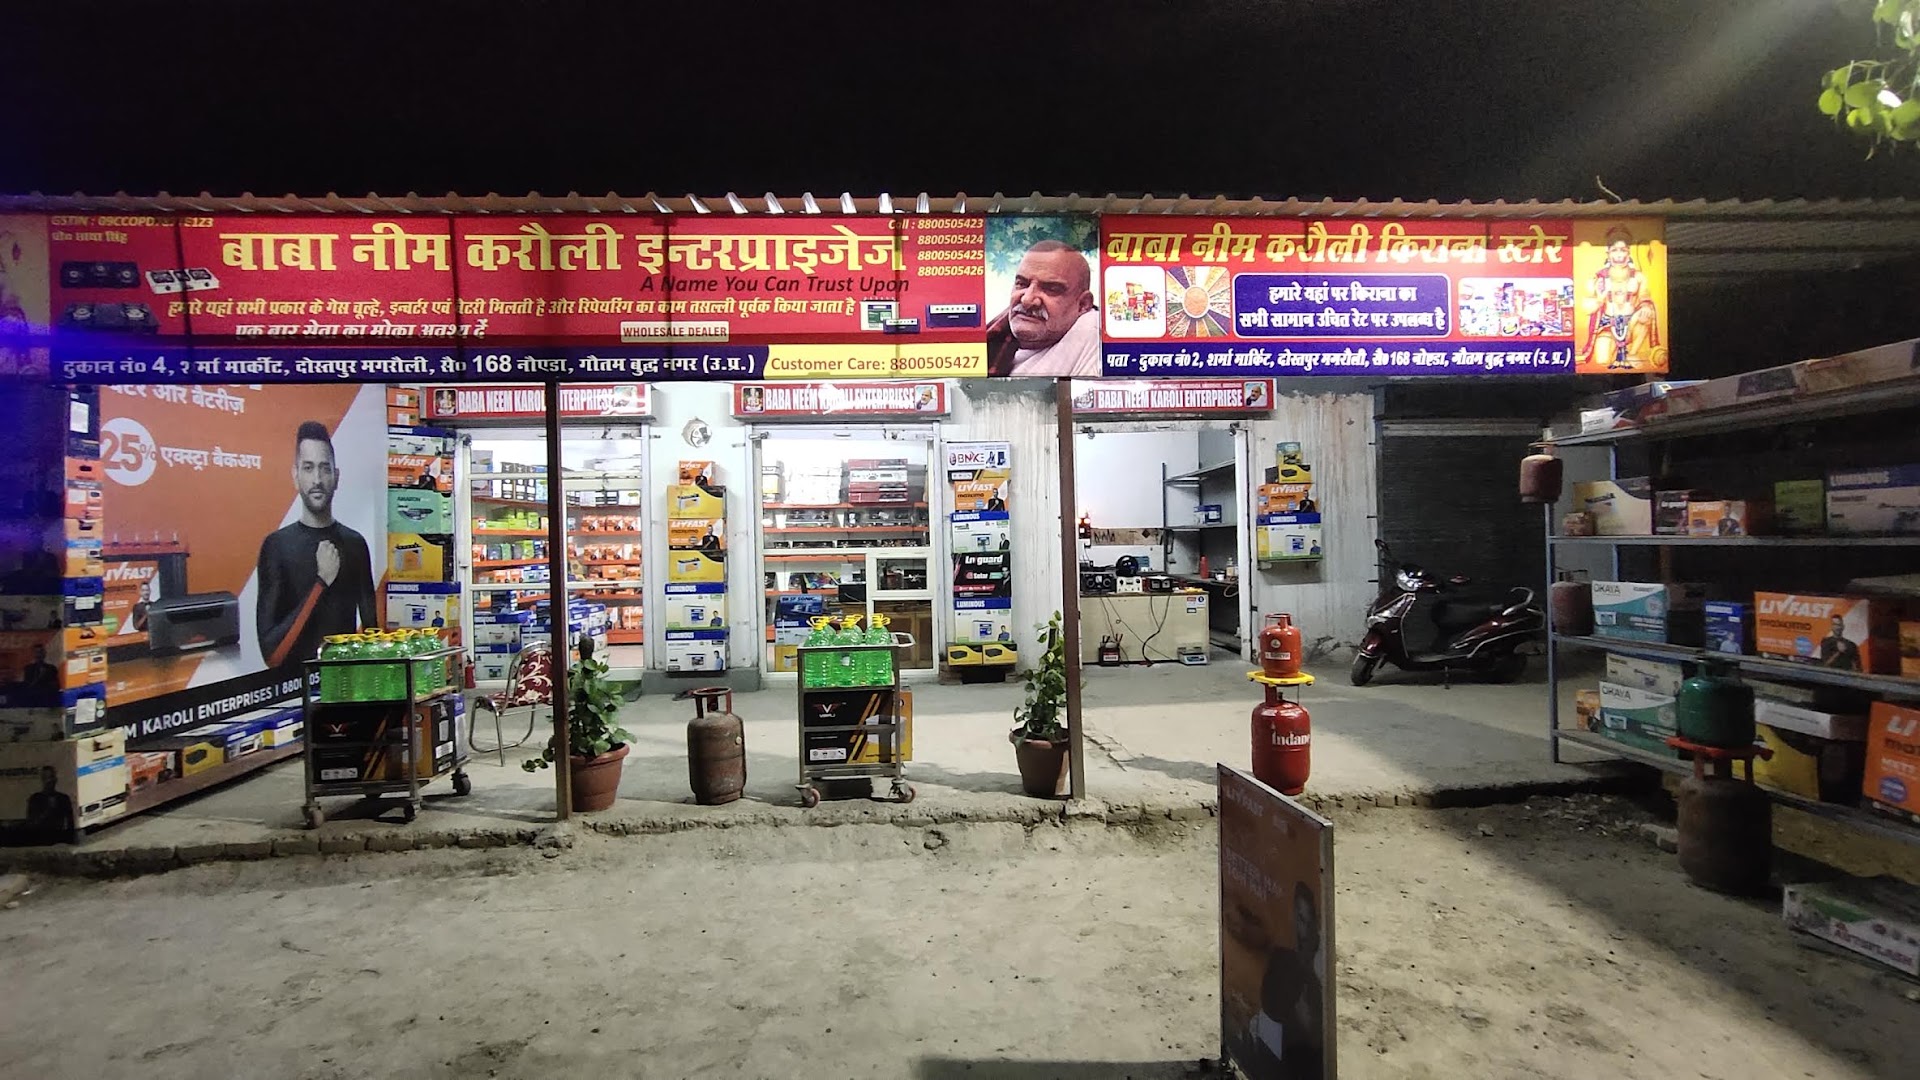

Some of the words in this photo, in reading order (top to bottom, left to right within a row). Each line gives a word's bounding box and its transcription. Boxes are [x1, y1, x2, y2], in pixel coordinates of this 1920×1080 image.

[917, 218, 984, 230] 8800505423
[219, 232, 339, 271] बाबा
[350, 222, 451, 272] नीम
[463, 221, 625, 272] करौली
[917, 234, 984, 245] 8800505424
[1106, 232, 1188, 263] बाबा
[1192, 221, 1262, 264] नीम
[1265, 221, 1374, 264] करौली
[1375, 221, 1494, 265] किराना
[1497, 223, 1569, 265] स्टोर
[917, 250, 984, 261] 8800505425
[917, 265, 984, 277] 8800505426
[639, 276, 655, 292] A
[660, 275, 718, 292] Name
[725, 275, 758, 292] You
[764, 275, 800, 292] Can
[806, 275, 854, 292] Trust
[859, 275, 909, 296] Upon
[1268, 281, 1303, 304] हमारे
[1304, 280, 1330, 304] यहां
[1330, 286, 1350, 302] पर
[1350, 280, 1397, 302] किराना
[1397, 286, 1418, 302] का
[236, 298, 265, 316] सभी
[309, 298, 324, 315] के
[488, 297, 534, 315] मिलती
[535, 297, 547, 316] है
[548, 297, 574, 315] और
[635, 299, 655, 314] का
[657, 298, 687, 315] काम
[689, 297, 736, 315] तसल्ली
[773, 297, 807, 314] किया
[810, 299, 842, 314] जाता
[844, 296, 855, 316] है
[1238, 307, 1269, 328] सभी
[1270, 312, 1315, 328] सामान
[1315, 307, 1351, 328] उचित
[1350, 307, 1370, 328] रेट
[1370, 312, 1389, 328] पर
[1435, 306, 1447, 331] है
[623, 326, 685, 338] WHOLESALE
[688, 326, 728, 337] DEALER
[63, 359, 115, 379] दुकान
[295, 356, 358, 379] दोस्तपुर
[472, 354, 513, 373] 168
[578, 354, 627, 373] गौतम
[629, 356, 659, 377] बुद्ध
[662, 356, 698, 373] नगर
[770, 356, 844, 371] Customer
[847, 356, 886, 371] Care:
[889, 355, 980, 370] 8800505427
[1106, 352, 1128, 368] पता
[1139, 352, 1173, 372] दुकान
[1390, 350, 1411, 367] 168
[1505, 351, 1534, 366] नगर
[458, 390, 485, 413] BABA
[486, 390, 513, 413] NEEM
[513, 389, 547, 412] KAROL
[765, 387, 792, 410] BABA
[792, 387, 818, 410] NEEM
[1099, 389, 1123, 409] BABA
[1124, 389, 1149, 409] NEEM
[1150, 388, 1184, 408] KAROLI
[1184, 388, 1243, 408] ENTERPRIESE
[1593, 583, 1621, 595] OKAYA
[1759, 595, 1834, 619] LIVFAST
[1601, 685, 1632, 701] OKAYA
[142, 707, 194, 736] KAROLI
[197, 687, 273, 719] ENTERPRISES
